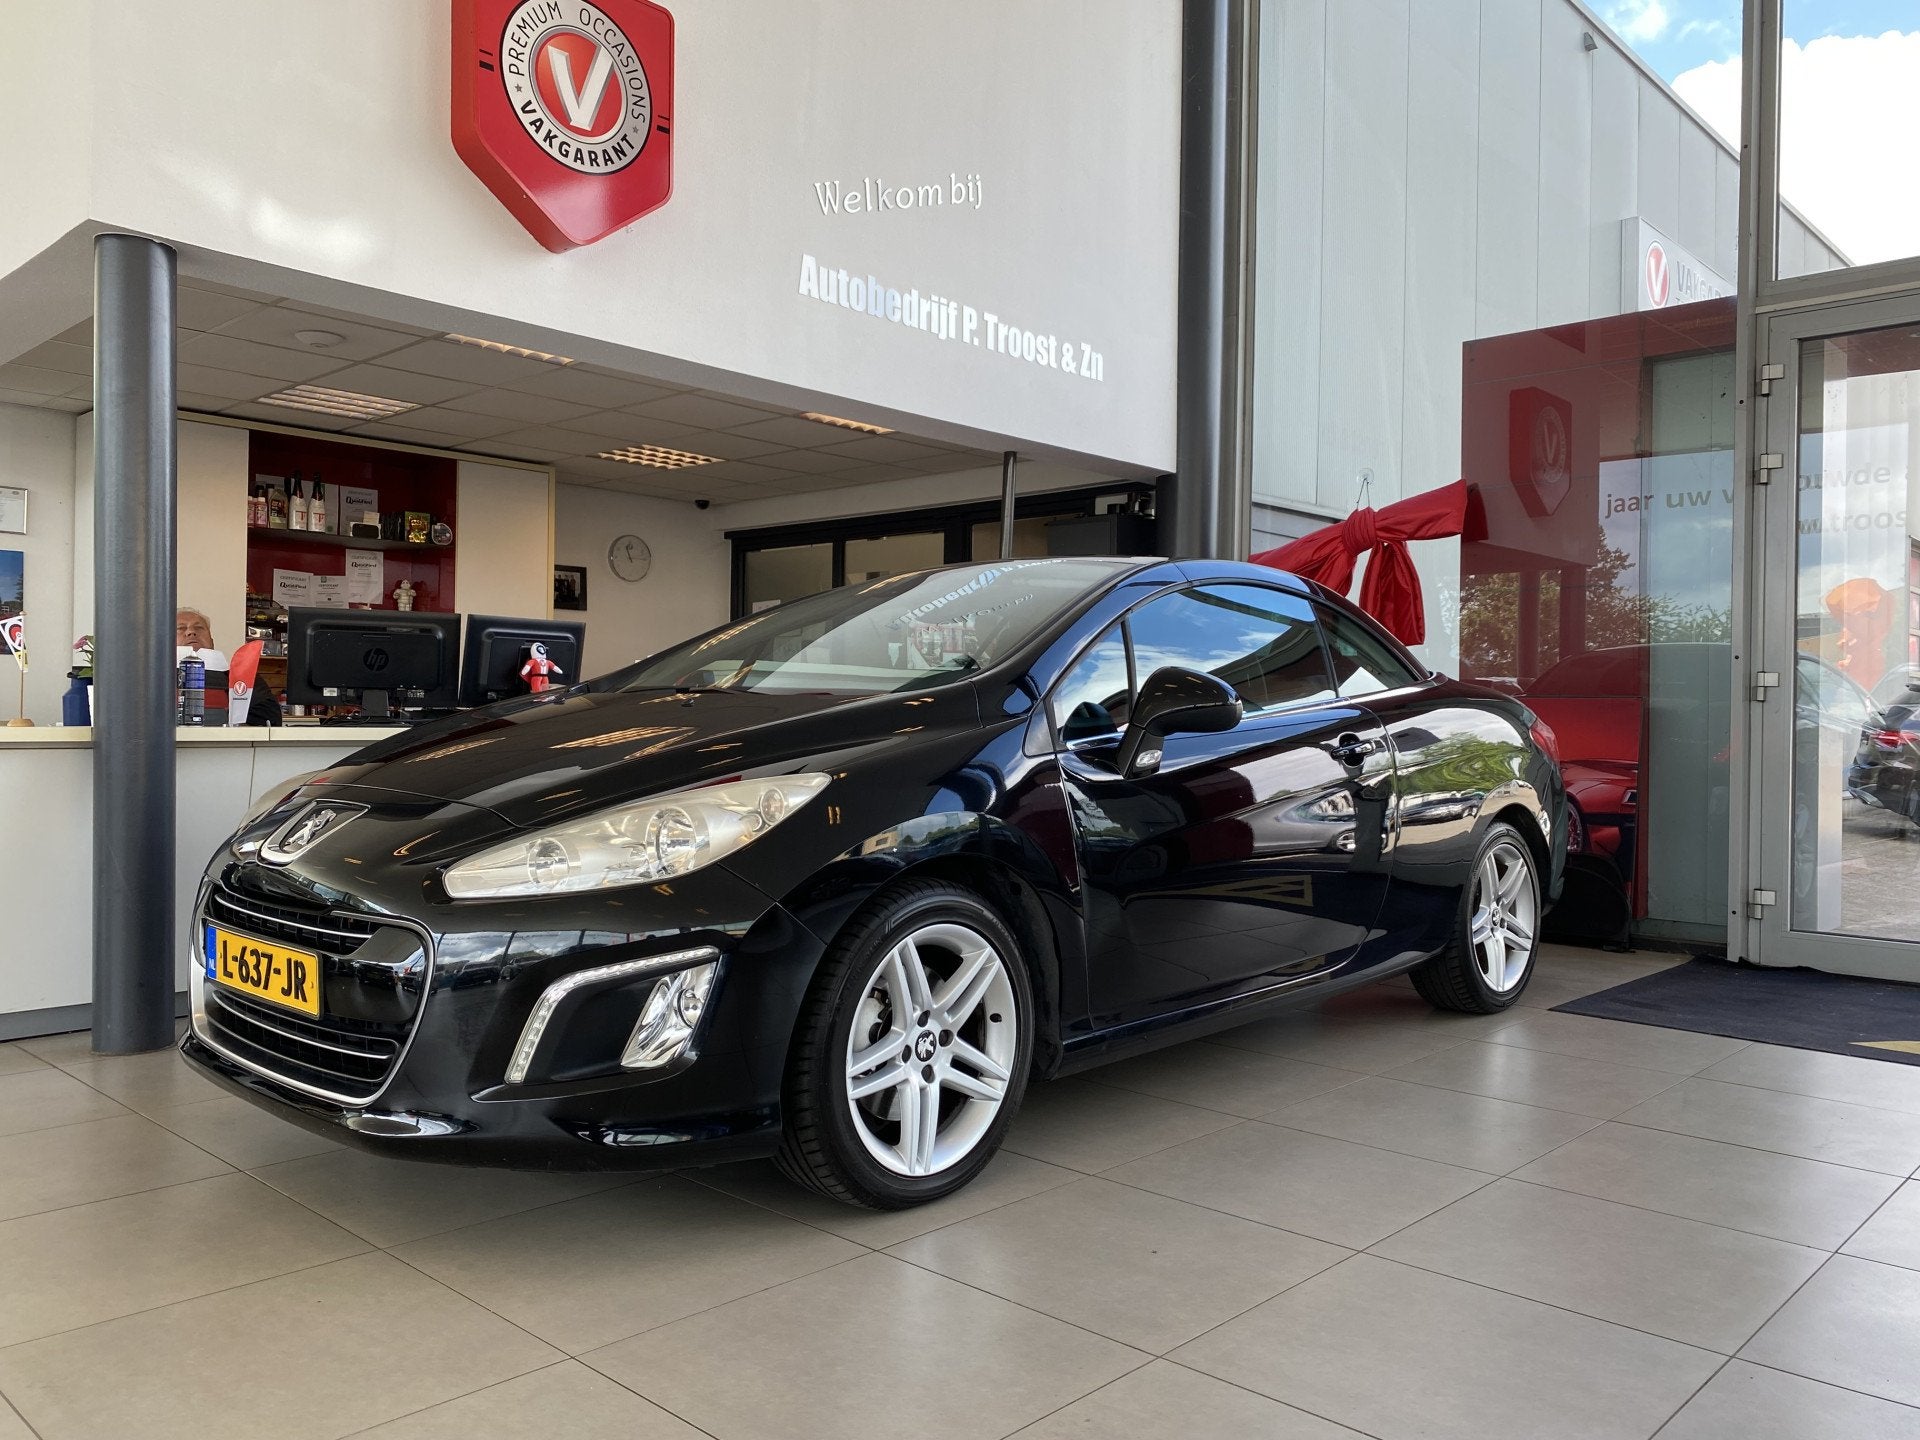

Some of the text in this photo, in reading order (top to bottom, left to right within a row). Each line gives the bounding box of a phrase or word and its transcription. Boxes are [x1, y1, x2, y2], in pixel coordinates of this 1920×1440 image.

[508, 1, 646, 123] PREMIUM OCCASIONS
[520, 99, 635, 167] VAKGARANT
[813, 172, 983, 216] Welkom bij
[798, 253, 1104, 382] Autobedrijf P. Troost & Zn
[1605, 493, 1655, 519] jaar
[1665, 488, 1712, 508] uw
[222, 940, 307, 1003] L-637-JR
